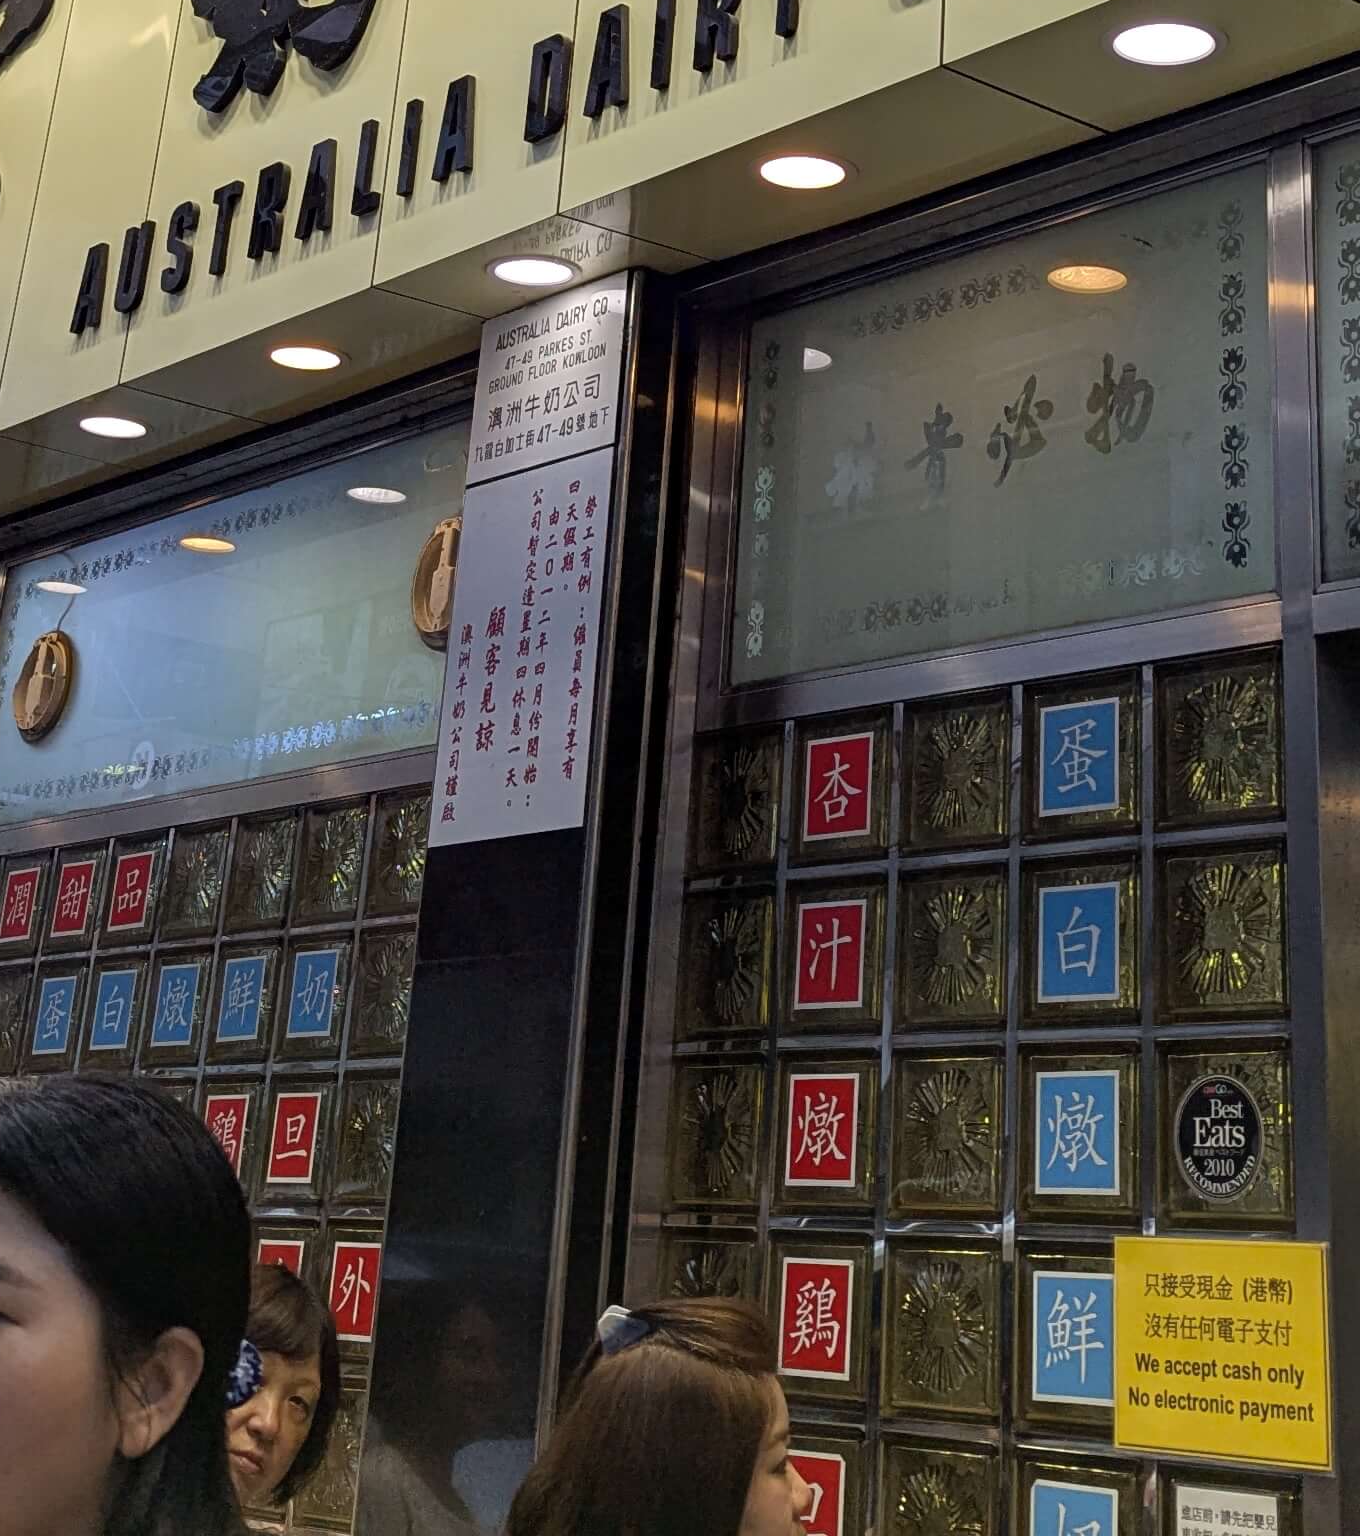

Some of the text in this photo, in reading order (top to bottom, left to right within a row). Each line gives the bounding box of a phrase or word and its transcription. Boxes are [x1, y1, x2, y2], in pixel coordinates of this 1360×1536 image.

[69, 74, 477, 334] AUSTRALIA
[495, 296, 611, 353] AUSTRALIA DAIRY CO.
[488, 342, 607, 395] GROUND FLOOR KOWLOON
[504, 350, 533, 372] 47-49
[538, 336, 574, 359] PARKES
[487, 373, 601, 433] 澳洲牛奶公司
[475, 605, 507, 752] 顧客見諒
[38, 965, 332, 1042] 蛋白燉鮮奶
[1208, 1098, 1245, 1119] Best
[1192, 1116, 1246, 1148] Eats
[1183, 1154, 1256, 1194] RECOMMENDED
[1203, 1158, 1235, 1177] 2010
[1143, 1272, 1293, 1305] 只接受現金 (港幣)
[1144, 1312, 1293, 1348] 沒有任何電子支付
[1135, 1352, 1305, 1390] We accept cash only
[1128, 1386, 1315, 1423] No electronic payment
